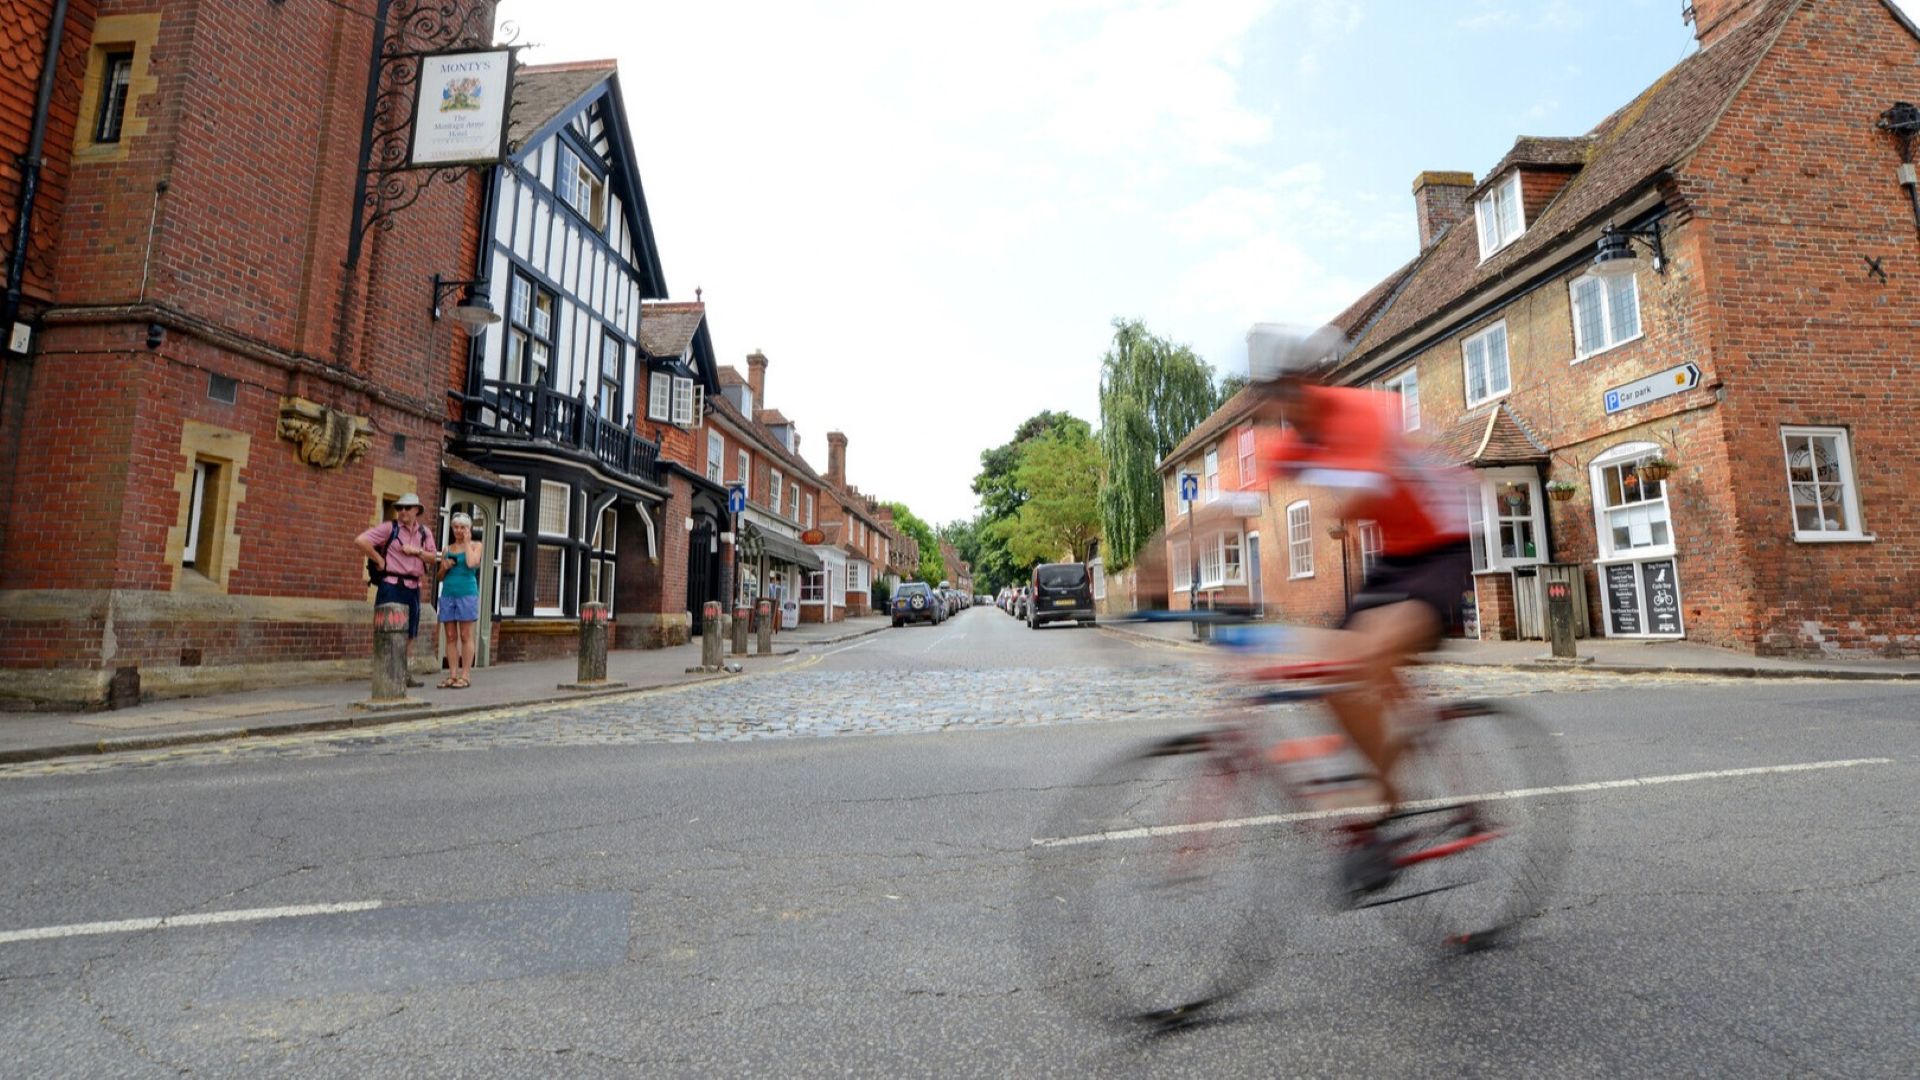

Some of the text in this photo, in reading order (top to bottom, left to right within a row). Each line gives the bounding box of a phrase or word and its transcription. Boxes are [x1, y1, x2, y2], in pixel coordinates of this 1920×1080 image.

[440, 62, 491, 74] MONTY'S
[1609, 386, 1652, 409] P Car park
